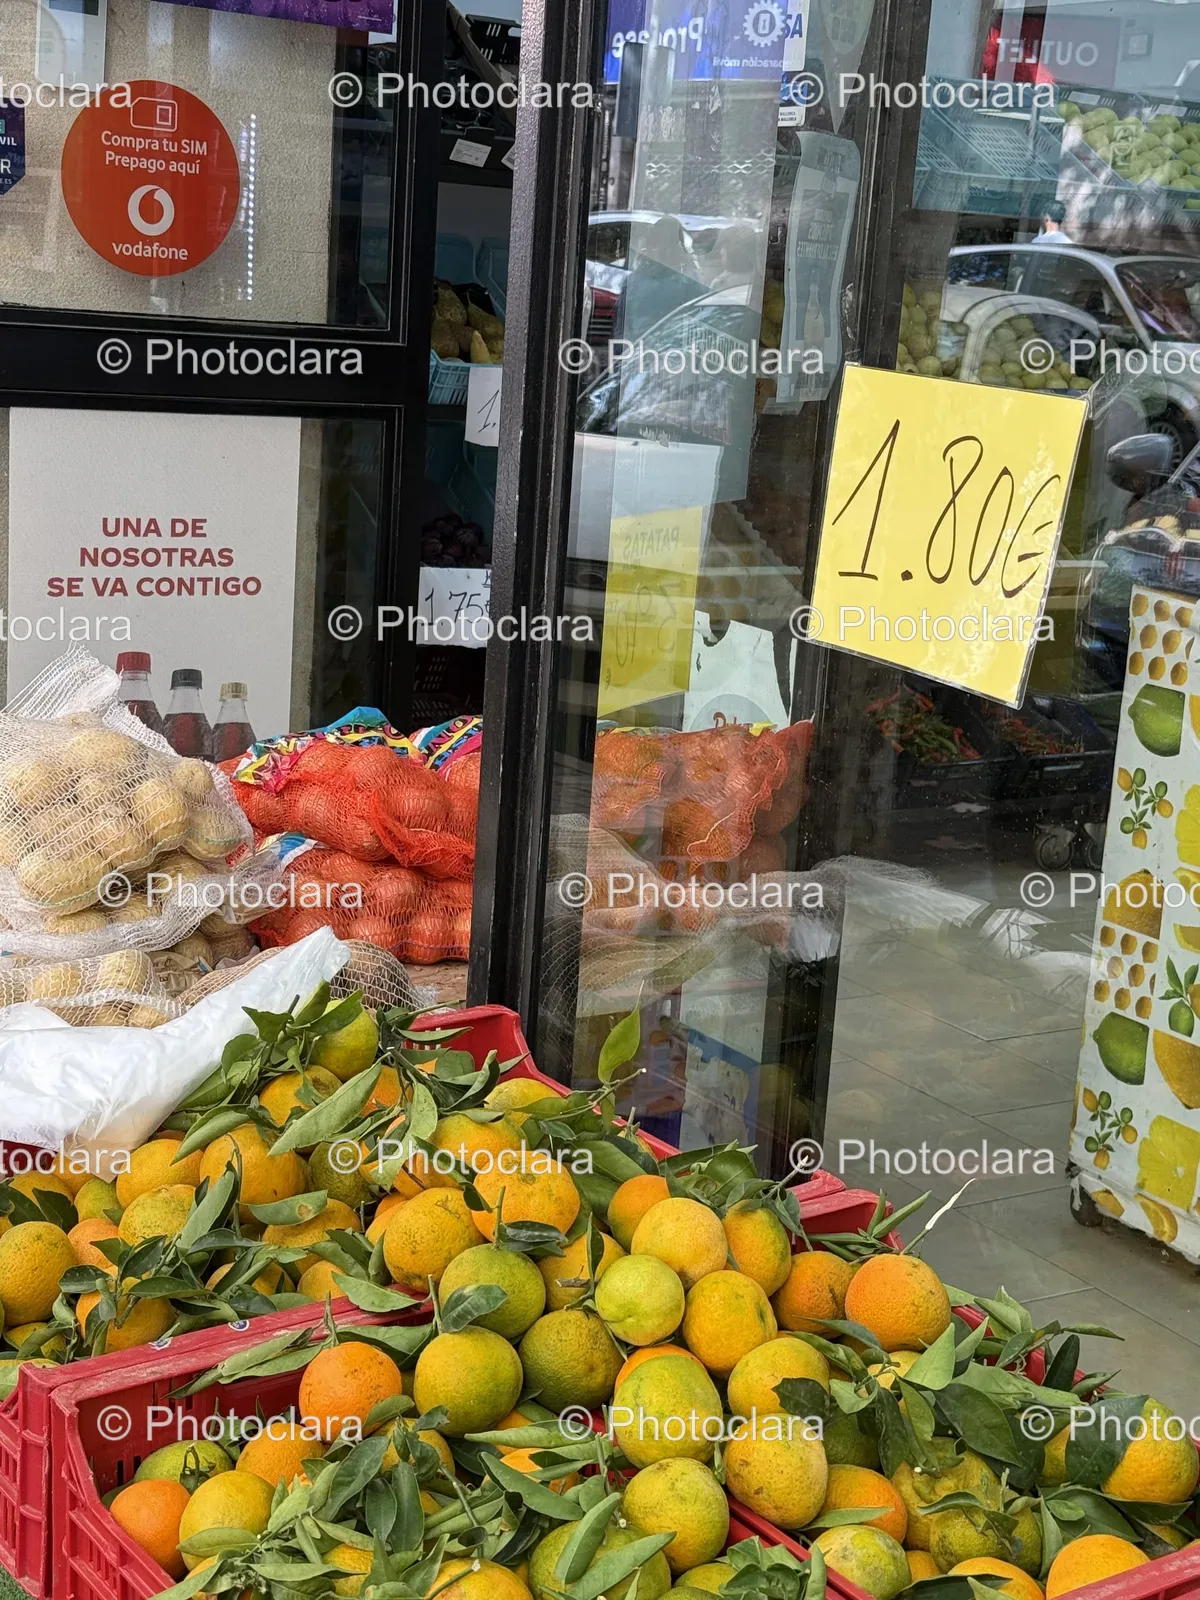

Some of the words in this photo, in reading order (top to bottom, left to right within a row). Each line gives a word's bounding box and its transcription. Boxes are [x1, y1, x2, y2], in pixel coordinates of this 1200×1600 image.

[101, 130, 159, 151] Compra
[162, 138, 178, 153] tu
[181, 139, 208, 155] SIM
[105, 150, 166, 173] Prepago
[169, 159, 200, 176] aquí
[112, 240, 189, 261] vodafone
[832, 418, 1061, 599] 1.80€
[102, 517, 162, 538] UNA
[170, 518, 207, 538] DE
[79, 546, 234, 567] NOSOTRAS
[47, 576, 84, 597] SE
[91, 576, 129, 597] VA
[136, 576, 262, 597] CONTIGO
